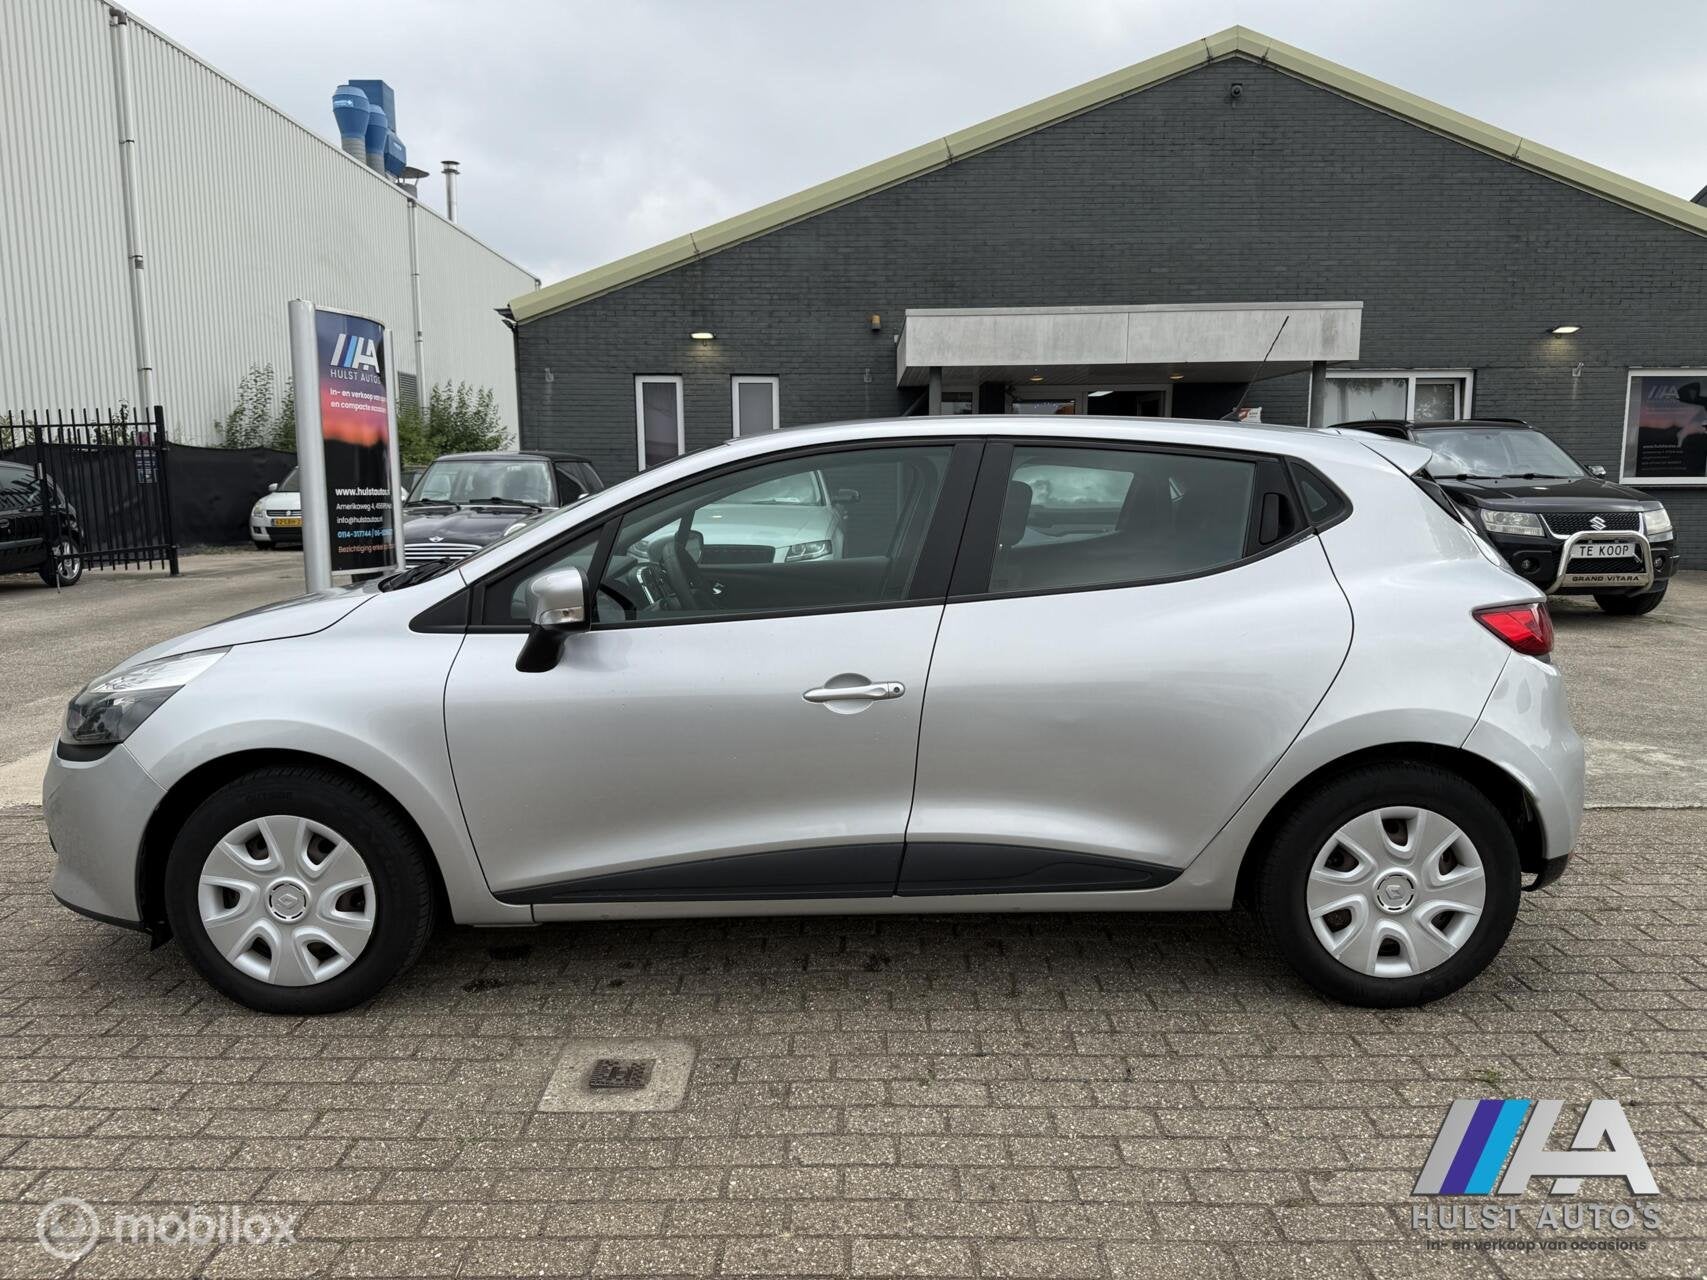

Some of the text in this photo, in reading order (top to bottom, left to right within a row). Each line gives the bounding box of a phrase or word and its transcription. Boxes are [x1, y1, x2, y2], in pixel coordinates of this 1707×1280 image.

[330, 368, 358, 381] HULST
[351, 391, 373, 402] verkoop
[1580, 545, 1629, 556] TE KOOP
